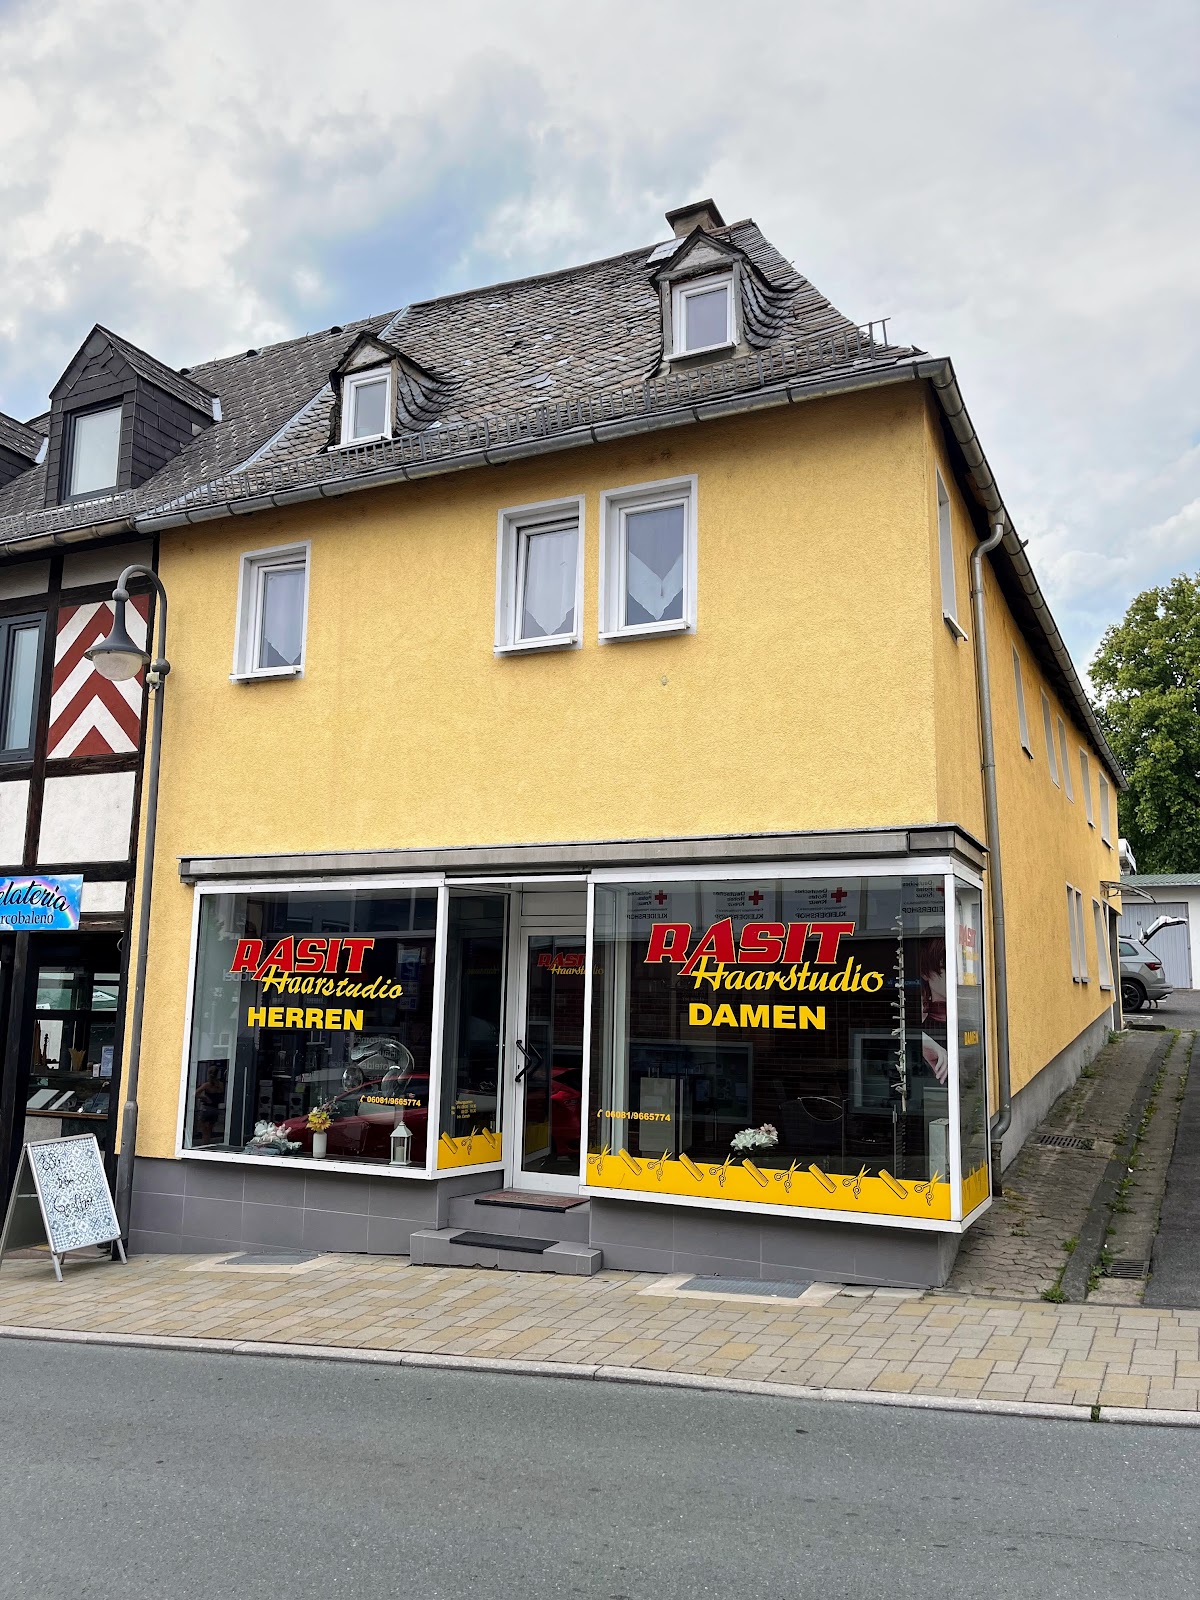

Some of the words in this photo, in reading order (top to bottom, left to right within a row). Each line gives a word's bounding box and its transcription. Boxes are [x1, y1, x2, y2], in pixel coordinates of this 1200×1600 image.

[229, 935, 375, 981] RASIT
[644, 917, 855, 975] RASIT
[537, 952, 586, 971] RASI
[691, 955, 884, 993] Haarstudio
[262, 965, 403, 999] Haarstudio
[247, 1006, 364, 1030] HERREN
[689, 1002, 826, 1030] DAMEN
[367, 1096, 421, 1107] 06081/9665774
[605, 1110, 671, 1122] 06081/9665774
